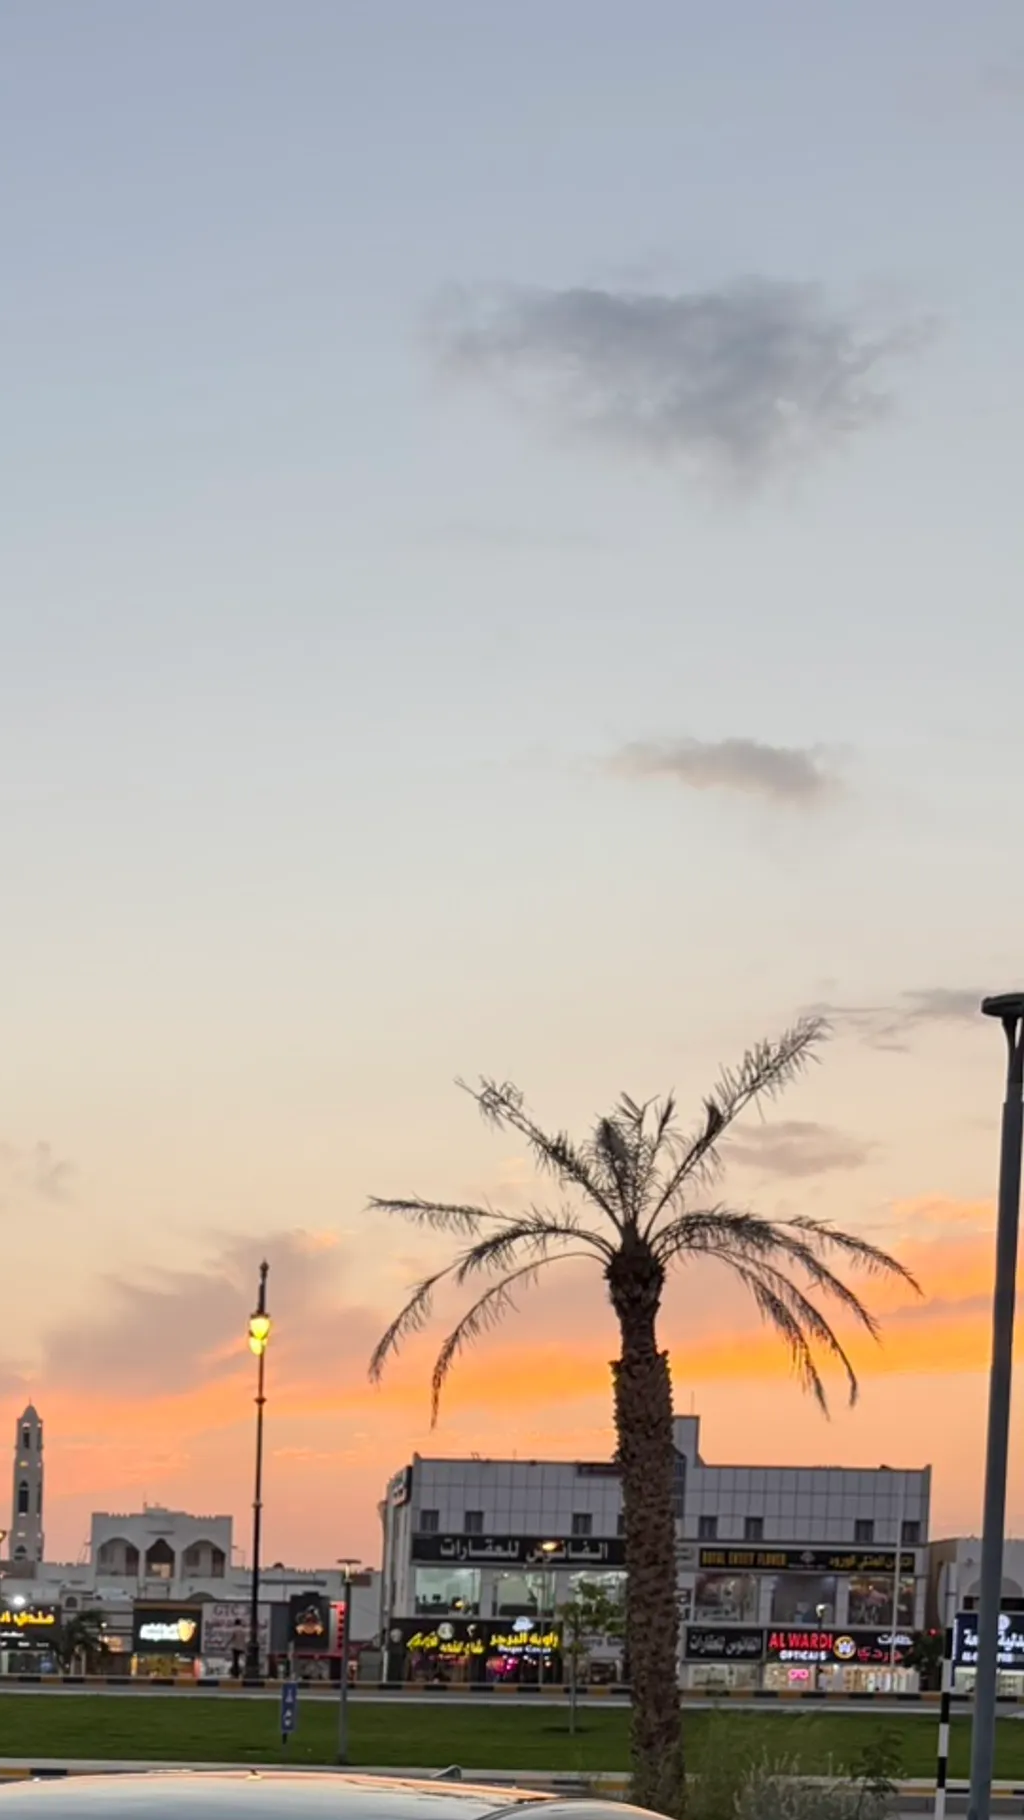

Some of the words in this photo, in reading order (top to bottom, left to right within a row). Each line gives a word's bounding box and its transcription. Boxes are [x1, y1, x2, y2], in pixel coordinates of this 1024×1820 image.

[440, 1538, 519, 1560] للعقارات
[768, 1632, 785, 1648] AL
[788, 1632, 833, 1649] WARDI
